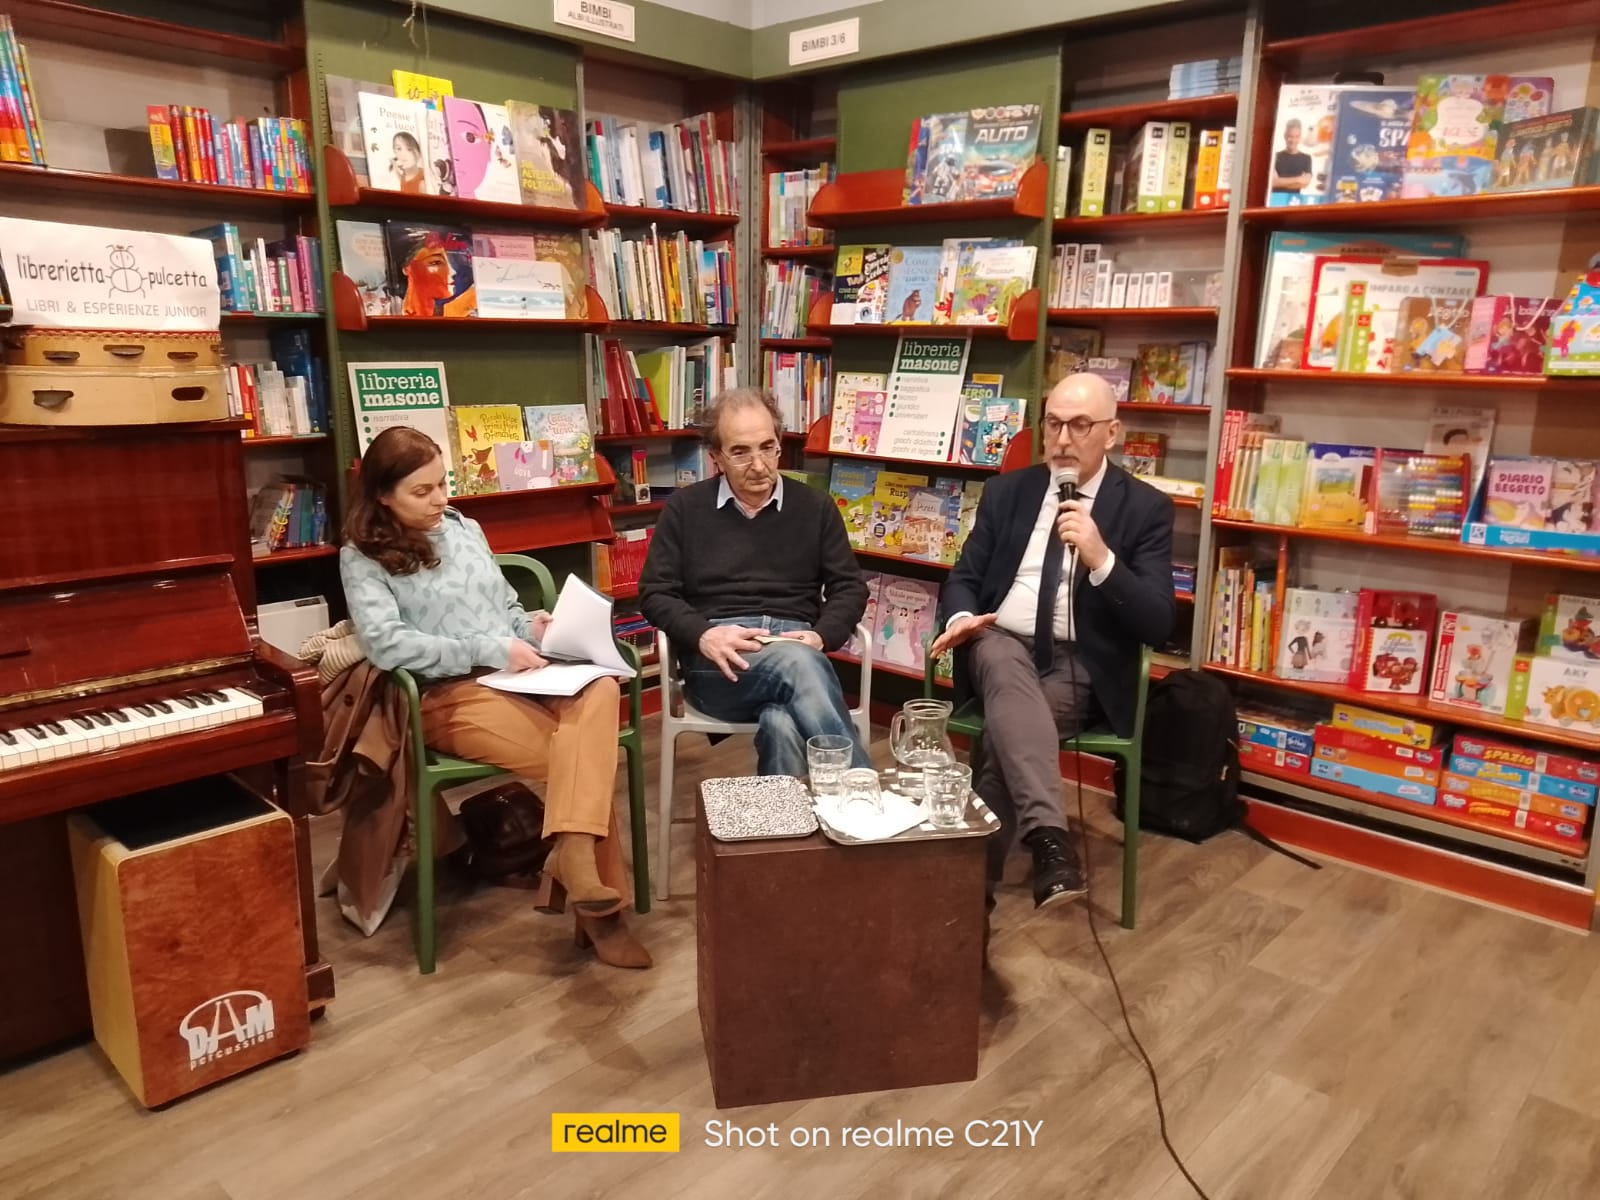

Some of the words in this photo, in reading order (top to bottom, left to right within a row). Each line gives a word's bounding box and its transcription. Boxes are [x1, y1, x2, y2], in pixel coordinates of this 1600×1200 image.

[580, 1, 611, 18] BIMBI
[801, 36, 829, 52] BIMBI
[830, 32, 846, 46] 3/6
[975, 126, 1029, 144] AUTO
[16, 253, 105, 284] librerietta
[147, 266, 208, 289] pulcetta
[1369, 285, 1412, 295] IMPARO
[26, 298, 61, 313] LIBRI
[66, 300, 77, 314] &
[83, 301, 160, 317] ESPERIENZE
[163, 304, 207, 318] JUNIOR
[902, 340, 962, 358] libreria
[899, 358, 960, 372] masone
[359, 373, 438, 391] libreria
[362, 392, 441, 408] masone
[1498, 472, 1545, 485] DIARIO
[1494, 482, 1547, 496] SEGRETO
[1483, 749, 1535, 766] SPAZIO
